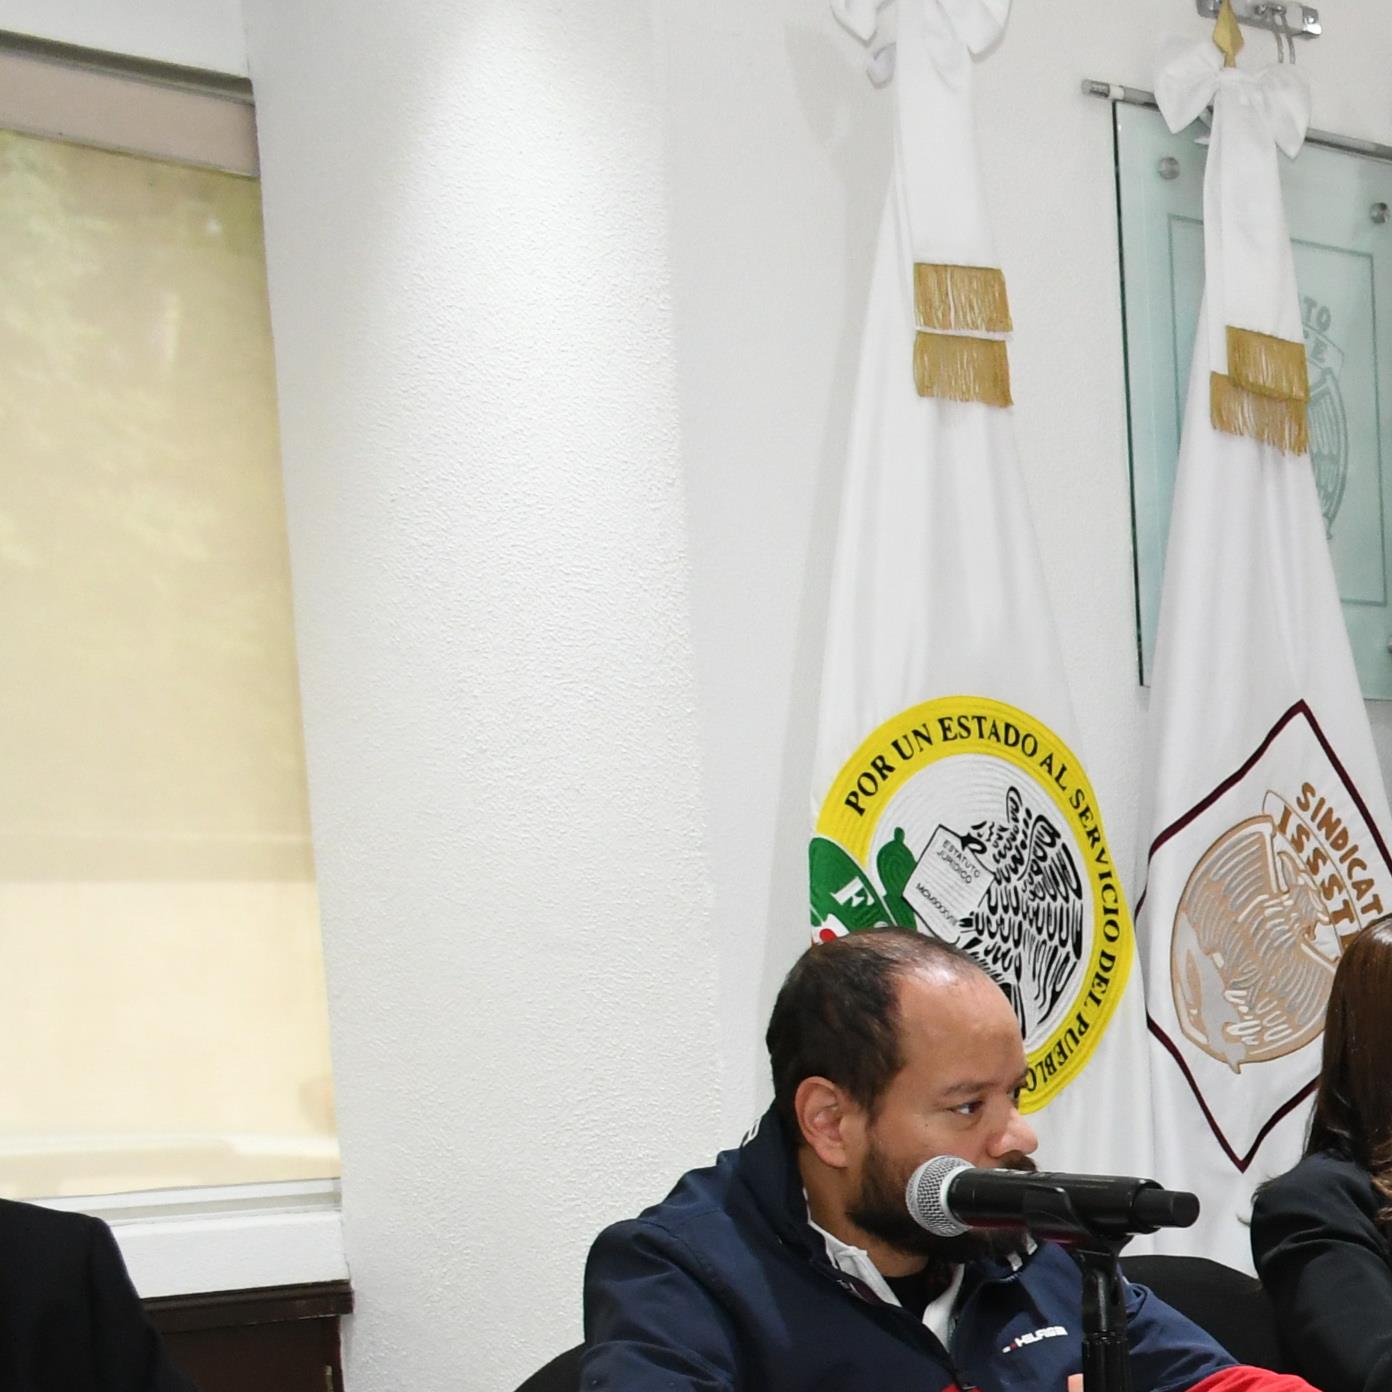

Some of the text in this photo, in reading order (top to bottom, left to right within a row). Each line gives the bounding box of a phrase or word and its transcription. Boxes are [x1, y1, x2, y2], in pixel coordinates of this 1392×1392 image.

[891, 723, 934, 761] UN
[938, 715, 1039, 757] ESTADO
[845, 754, 895, 816] POR
[1040, 753, 1069, 791] AL
[942, 839, 981, 878] ESTATUTO
[1068, 788, 1121, 943] SERVICIO
[1296, 782, 1384, 925] SINDICAT
[1088, 949, 1116, 1007] DEL
